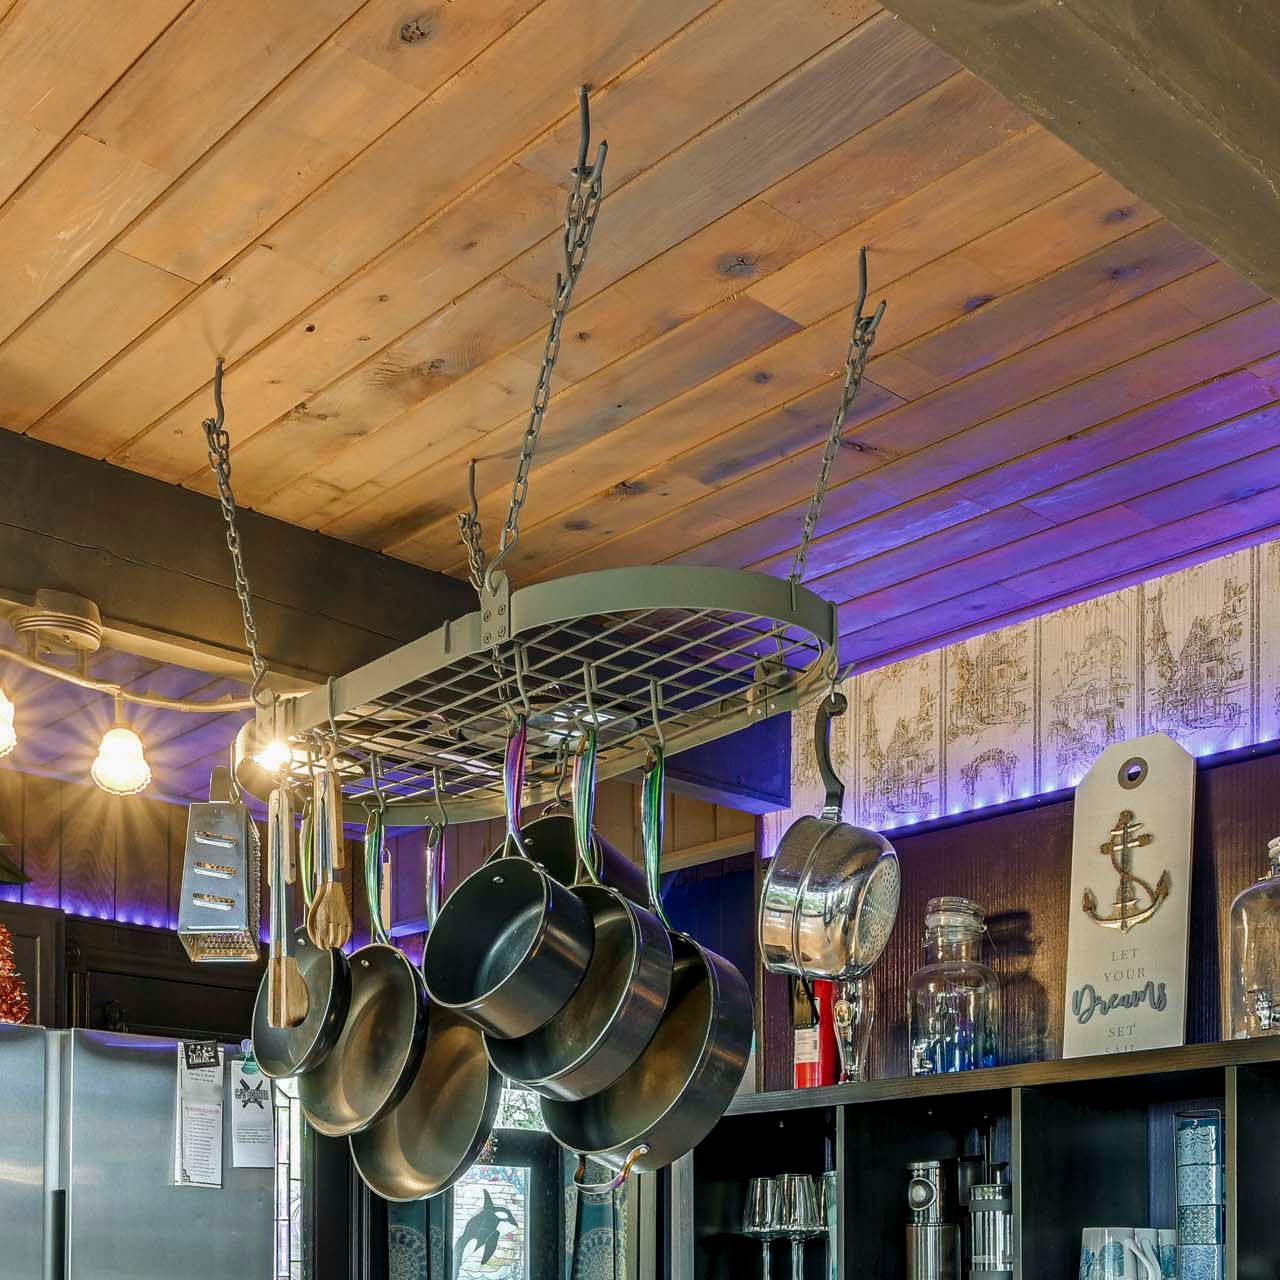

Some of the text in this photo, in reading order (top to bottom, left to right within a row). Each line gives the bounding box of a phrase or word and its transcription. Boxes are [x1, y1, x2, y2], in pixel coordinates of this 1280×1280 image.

[1111, 948, 1139, 961] LET
[1104, 968, 1145, 982] YOUR
[1072, 981, 1167, 1024] Dreams
[1108, 1025, 1136, 1037] SET
